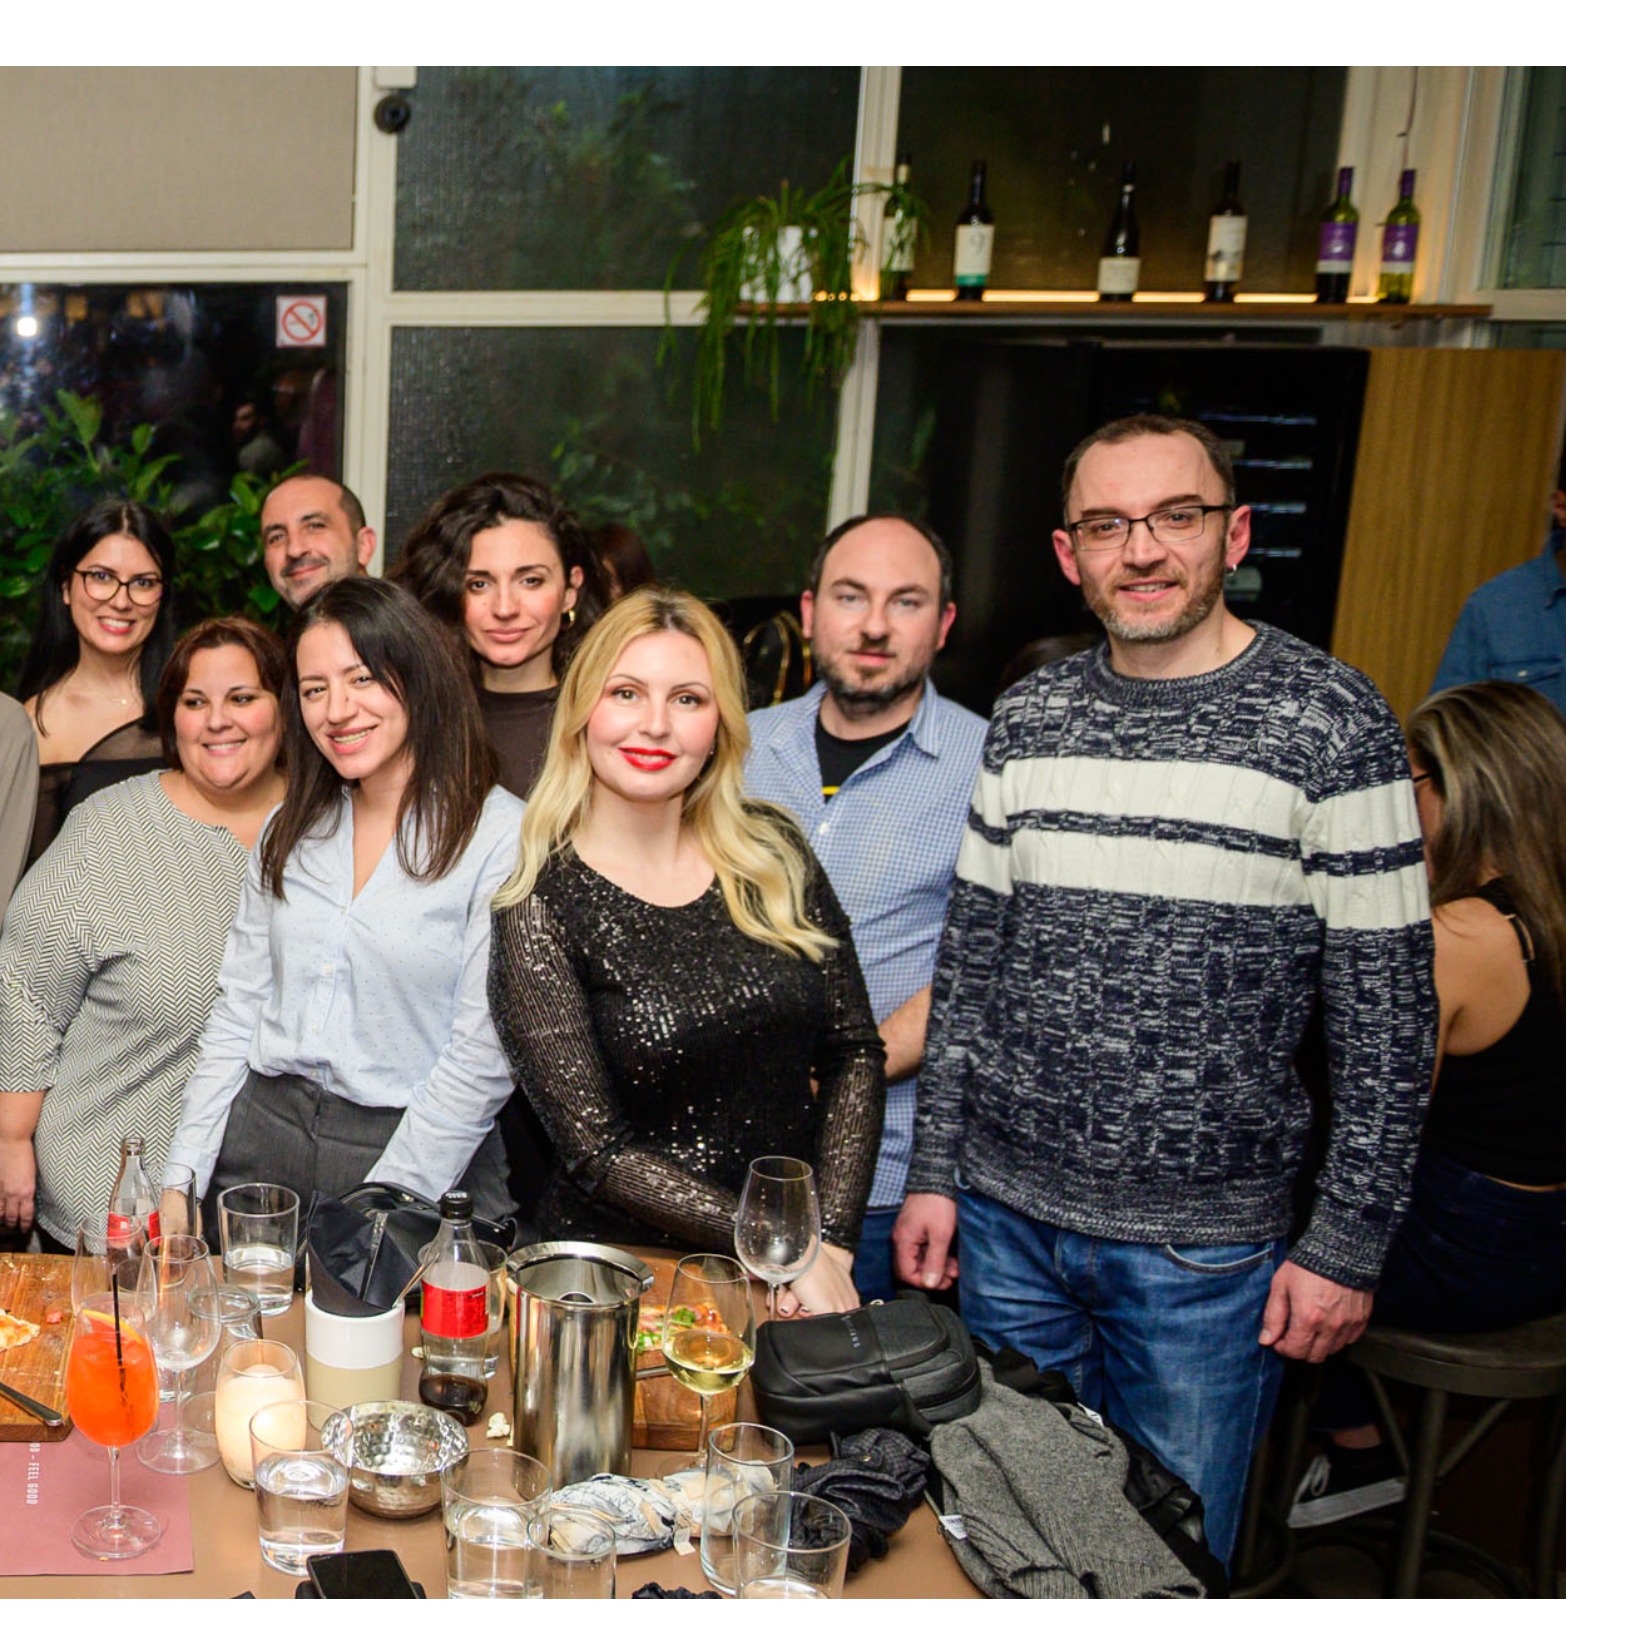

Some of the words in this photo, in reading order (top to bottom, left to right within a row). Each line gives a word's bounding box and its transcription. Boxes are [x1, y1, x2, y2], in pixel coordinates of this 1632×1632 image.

[29, 1442, 41, 1453] OD
[27, 1462, 40, 1481] FEEL
[26, 1483, 39, 1505] GOOD
